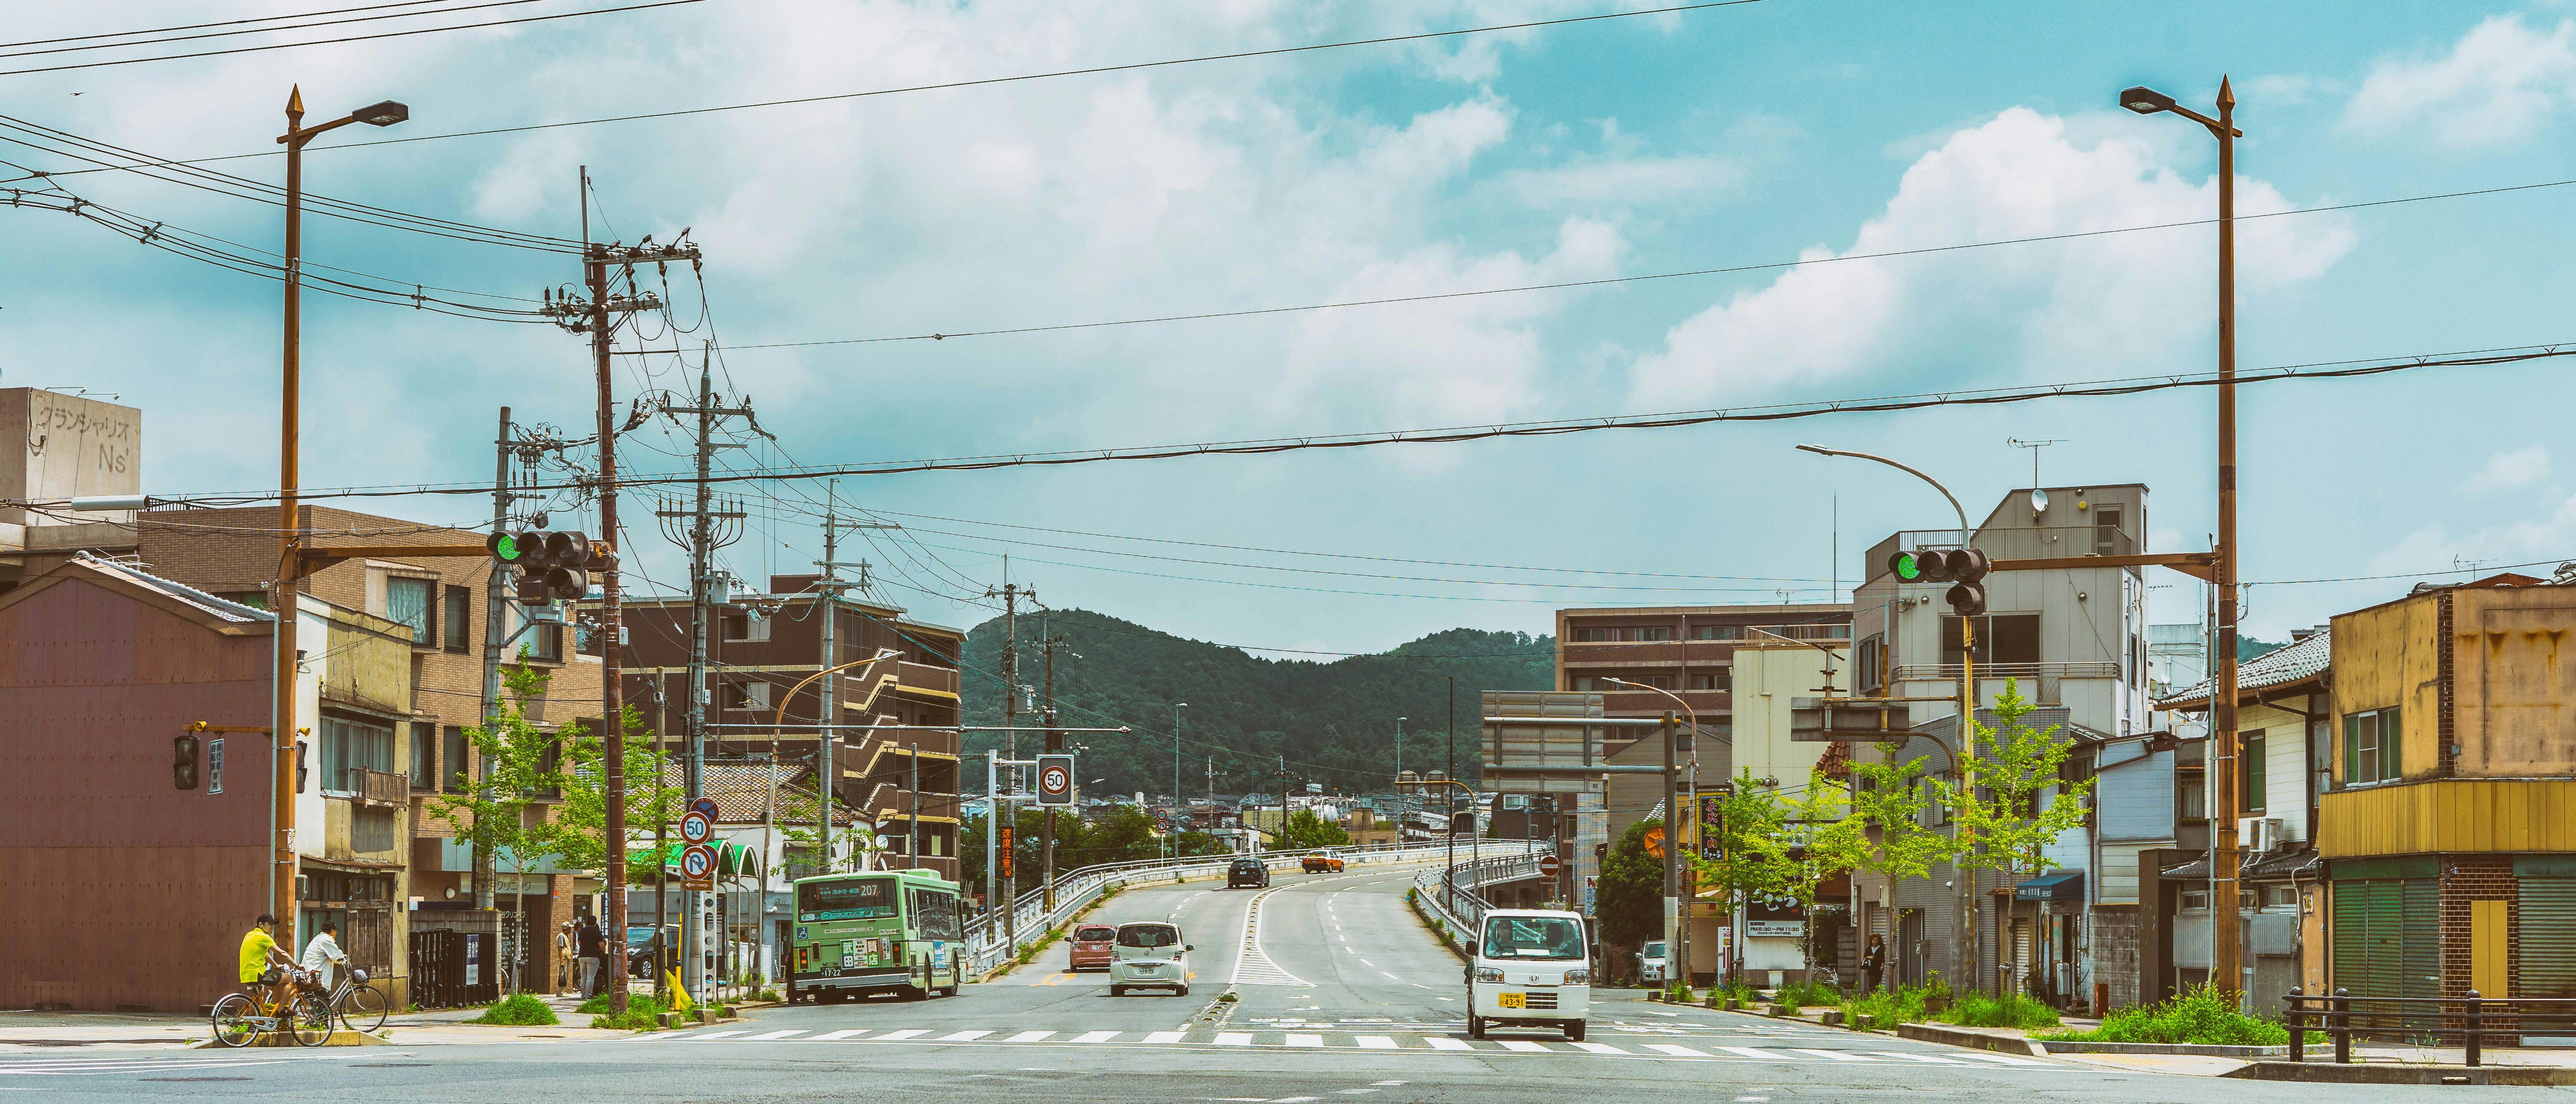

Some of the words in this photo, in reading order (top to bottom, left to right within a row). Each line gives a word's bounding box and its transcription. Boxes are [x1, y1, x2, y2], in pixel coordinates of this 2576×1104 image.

[1048, 774, 1063, 787] 50
[687, 821, 704, 836] 50
[1002, 828, 1012, 867] 速度注意
[497, 881, 531, 891] クリニク
[861, 885, 877, 896] 207
